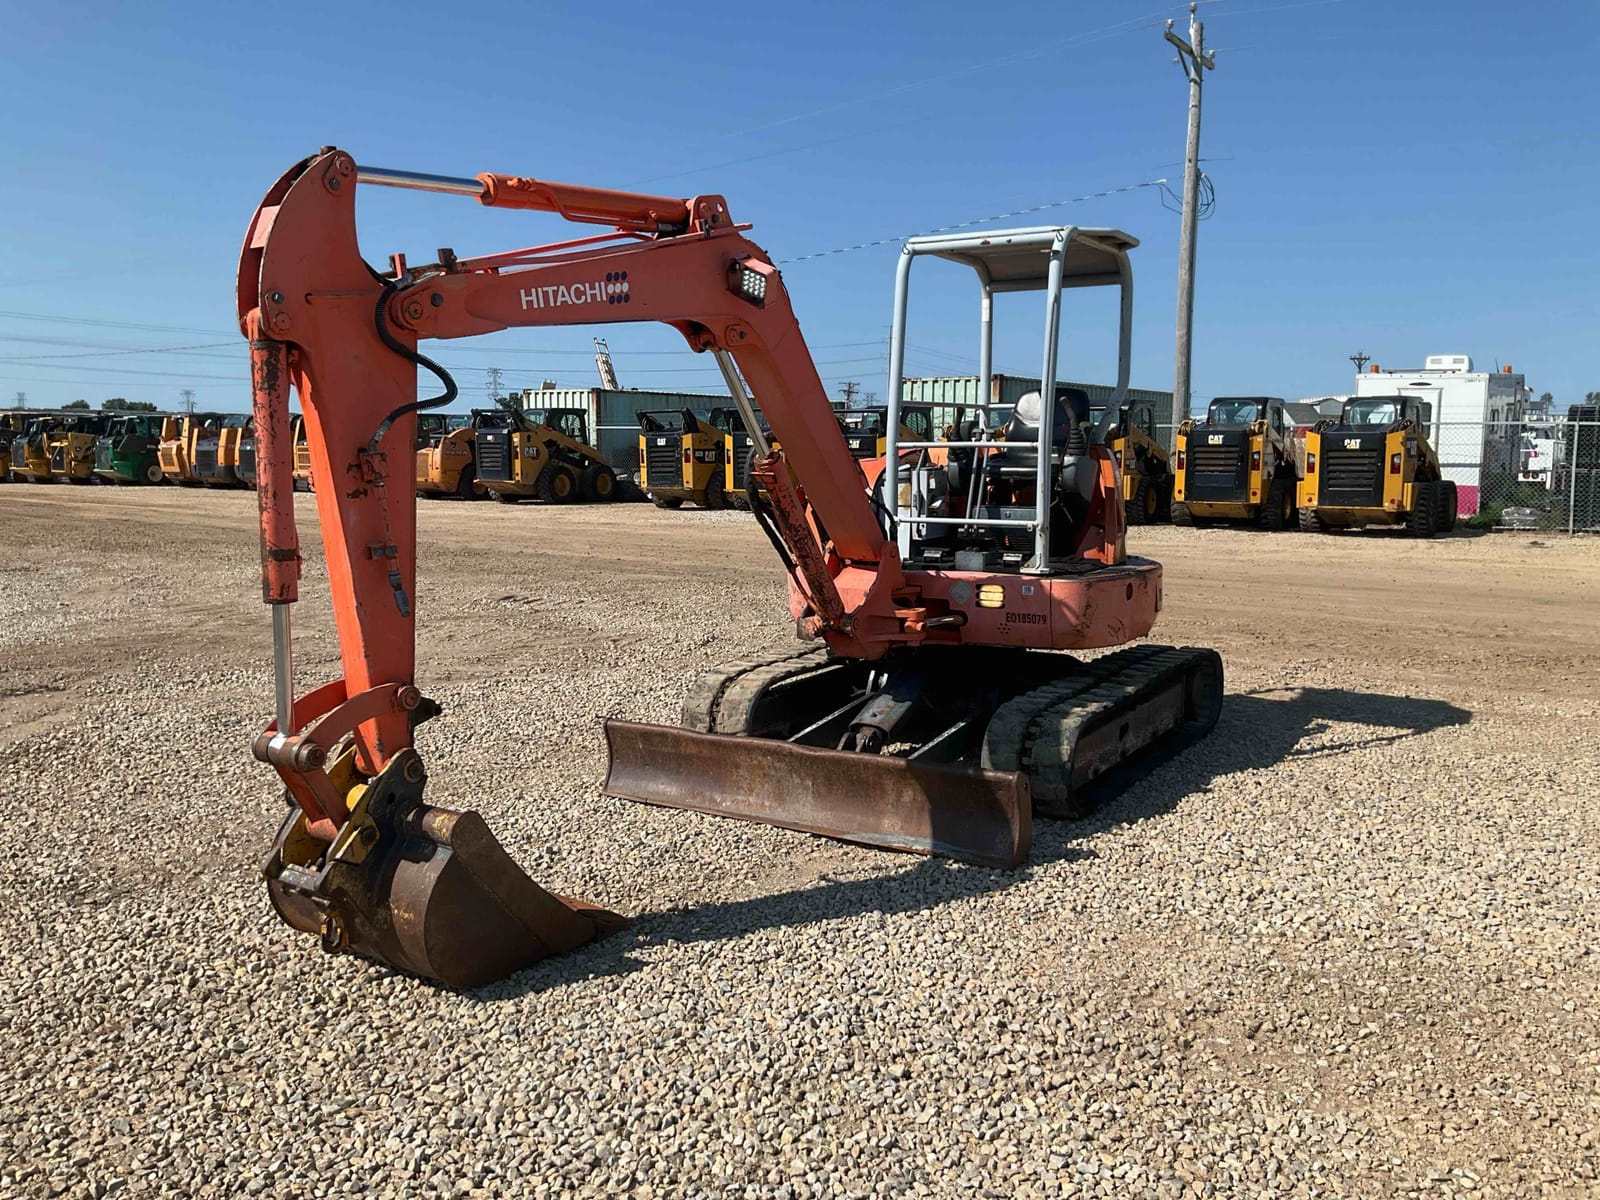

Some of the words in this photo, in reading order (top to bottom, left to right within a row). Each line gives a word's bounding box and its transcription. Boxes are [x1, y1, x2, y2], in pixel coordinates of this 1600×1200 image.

[520, 281, 607, 310] HITACHI
[1208, 434, 1224, 445] CAT
[1344, 439, 1361, 450] CAT
[524, 447, 538, 457] CAT
[705, 451, 716, 462] CAT
